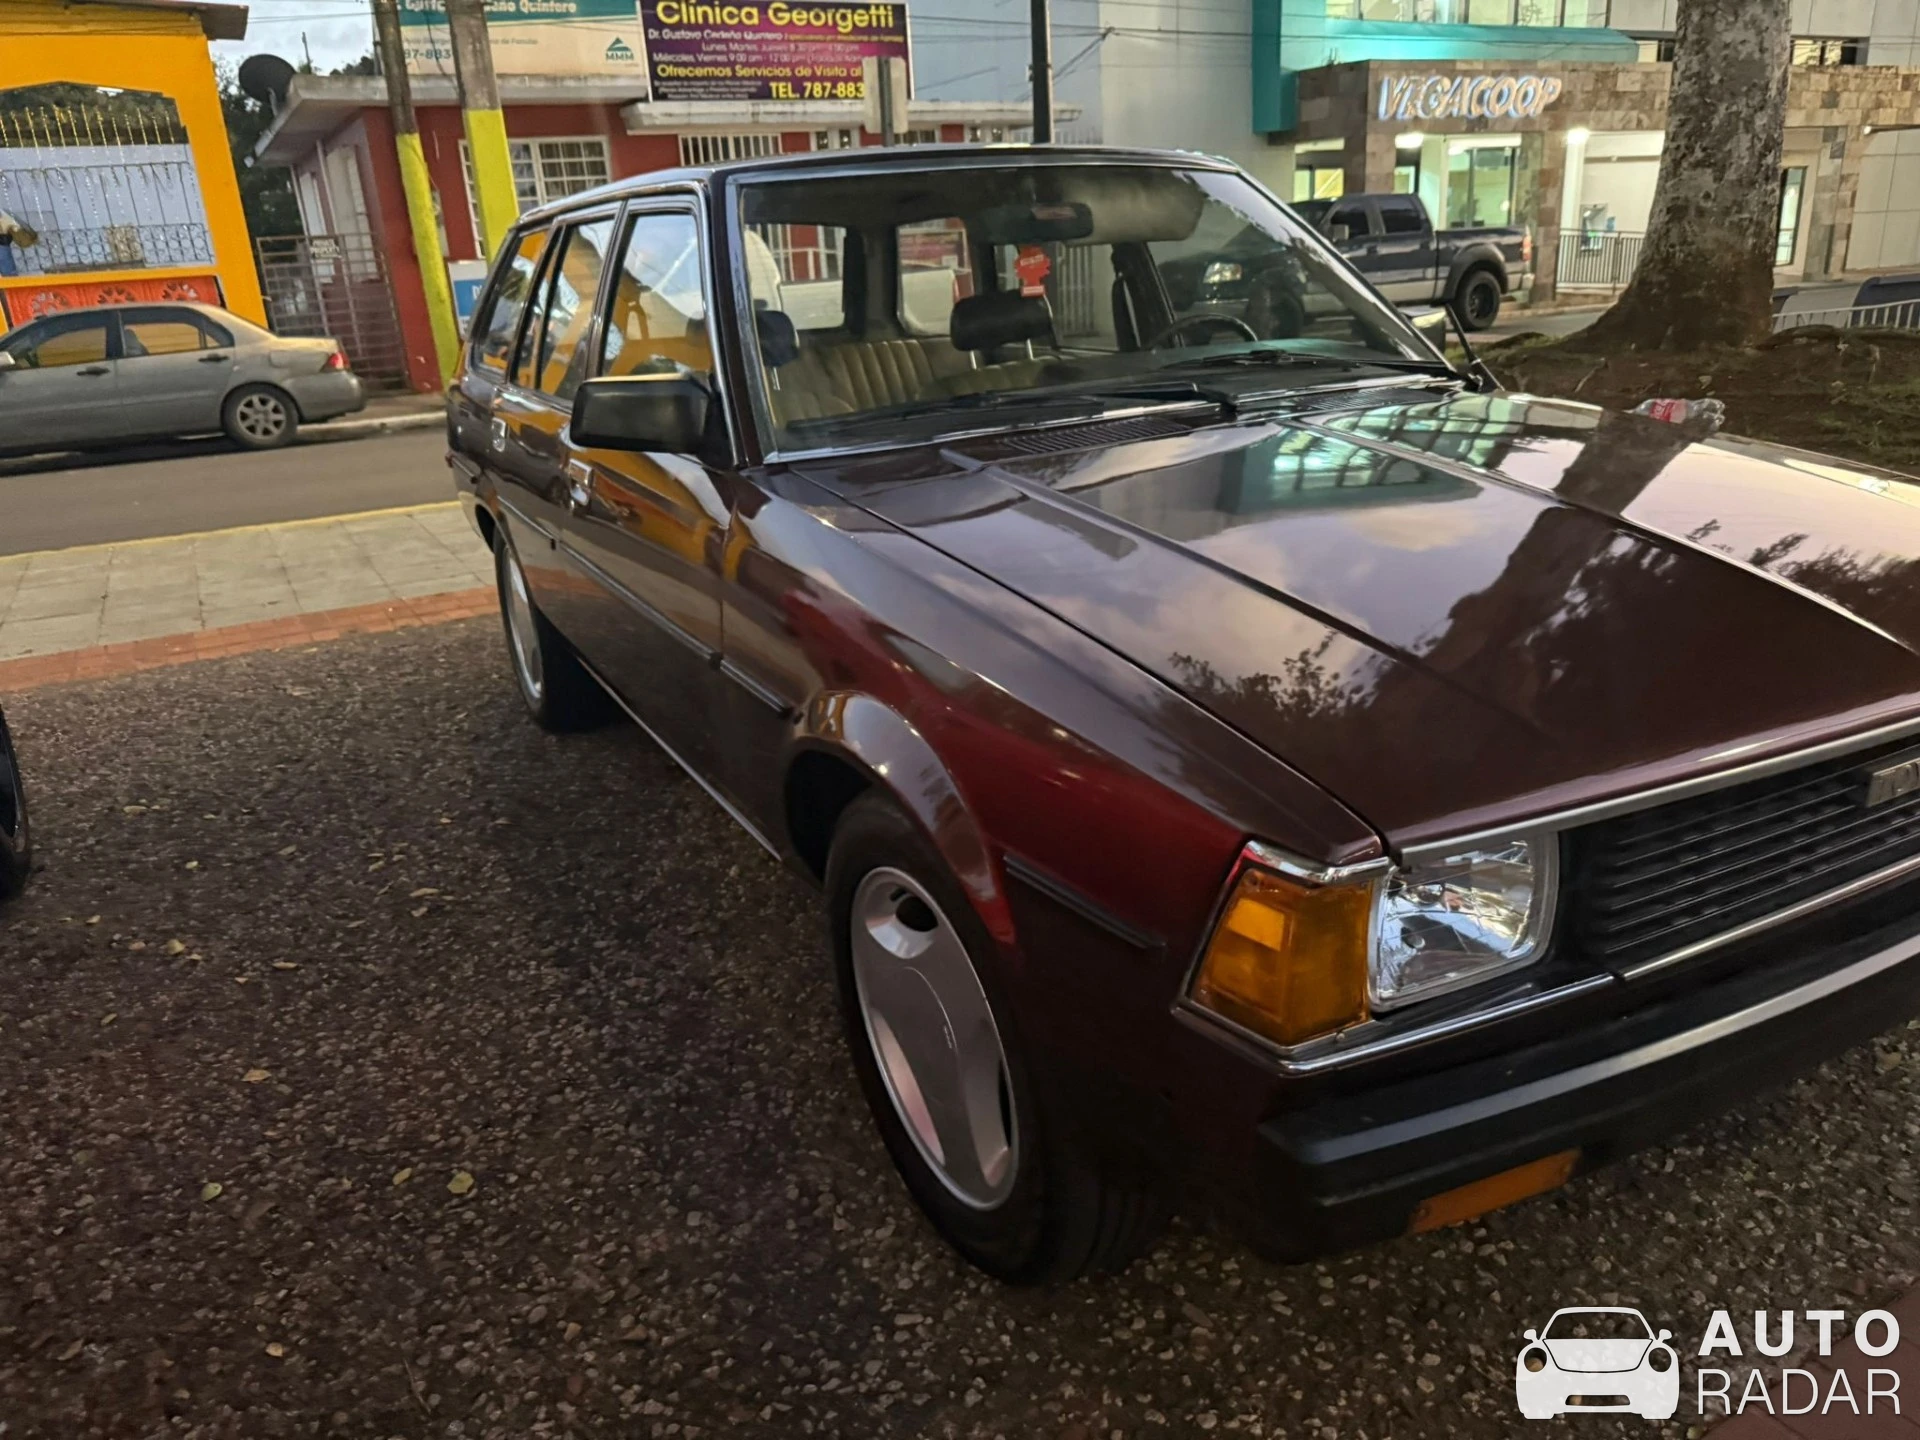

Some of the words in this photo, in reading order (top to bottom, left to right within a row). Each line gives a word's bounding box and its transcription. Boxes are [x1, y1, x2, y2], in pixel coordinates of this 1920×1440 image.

[767, 2, 894, 33] Georgetti
[647, 29, 661, 40] Dr.
[662, 29, 701, 40] Gustavo
[403, 48, 451, 59] 87-883
[605, 52, 634, 61] MMM
[656, 64, 732, 77] Ofrecemos
[734, 64, 792, 77] Servicios
[794, 66, 812, 77] de
[814, 65, 847, 77] Visita
[849, 66, 863, 77] al
[769, 81, 801, 98] TEL.
[802, 81, 865, 99] 787-883
